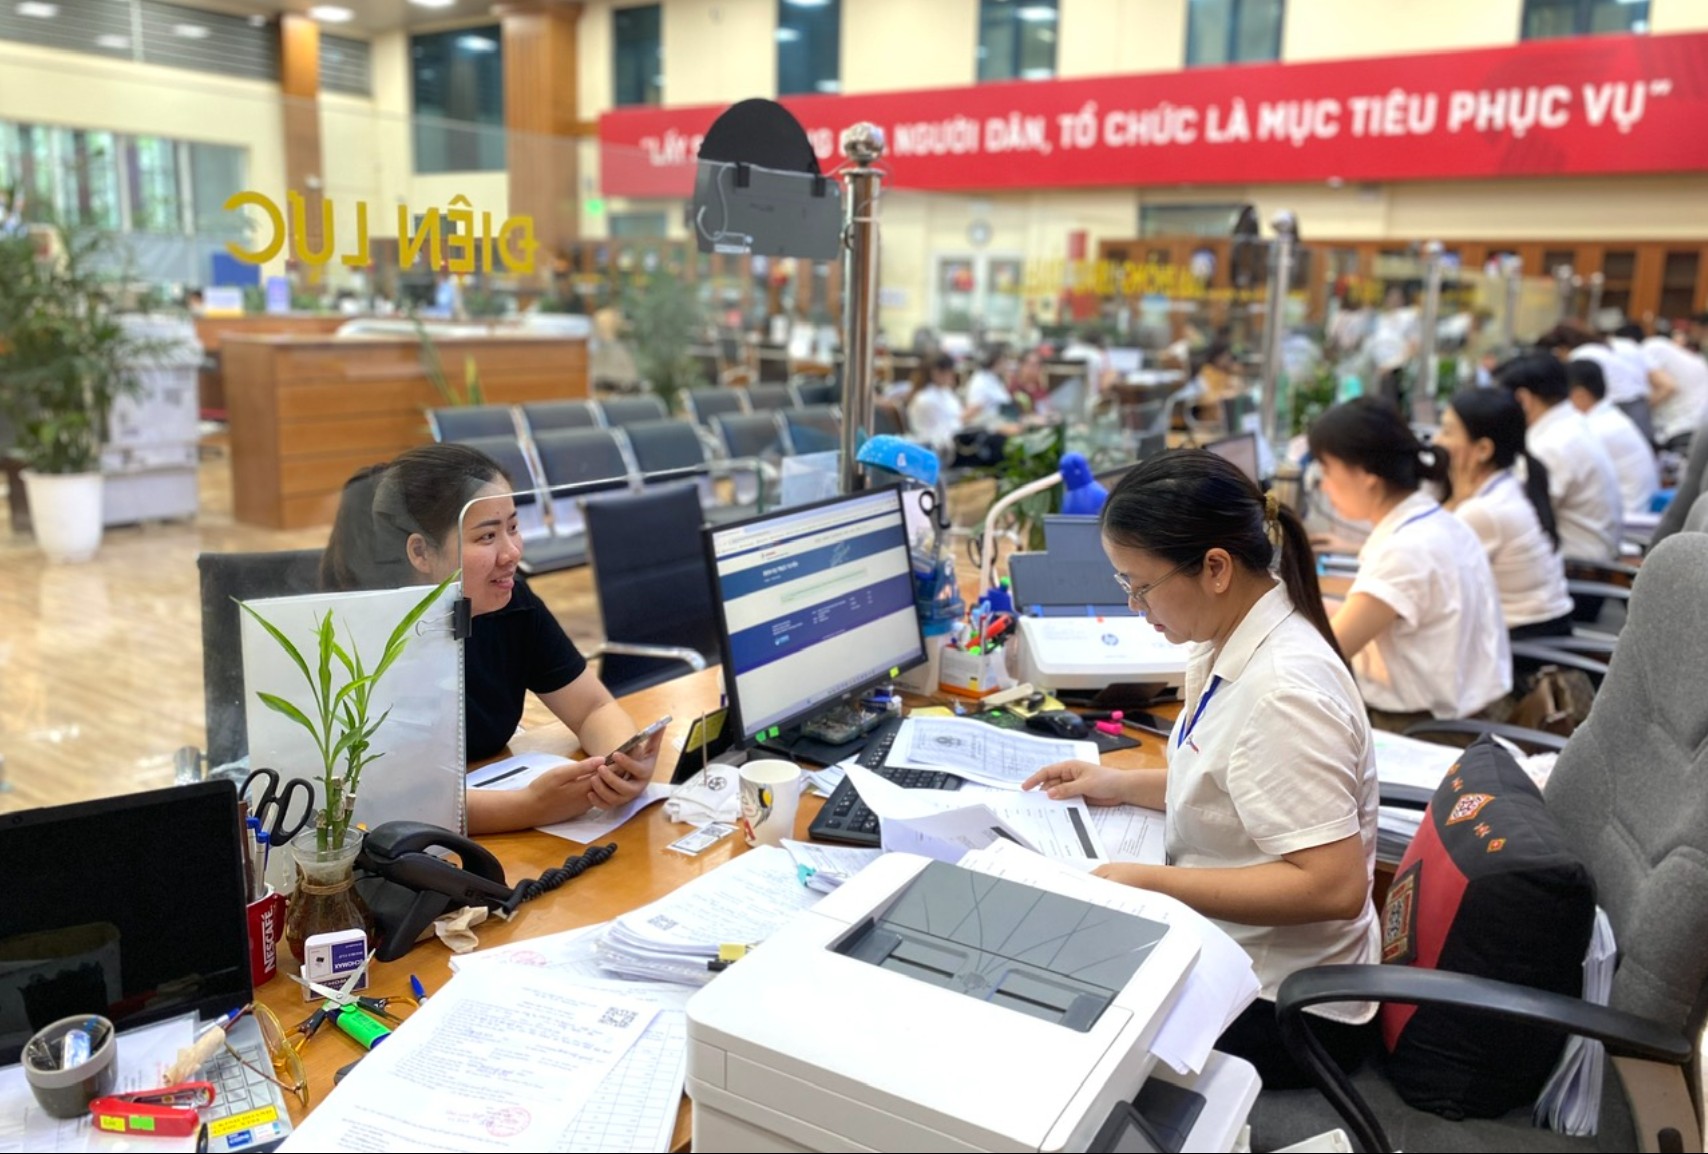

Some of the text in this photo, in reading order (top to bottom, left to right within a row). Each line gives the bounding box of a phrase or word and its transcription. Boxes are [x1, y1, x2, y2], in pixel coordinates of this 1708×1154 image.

[893, 115, 980, 156] NGƯỜI
[984, 111, 1053, 155] DÂN,
[1057, 100, 1098, 149] TỔ
[1103, 101, 1199, 147] CHỨC
[1205, 97, 1251, 143] LÀ
[1257, 98, 1341, 147] MỤC
[1347, 87, 1438, 137] TIÊU
[1447, 84, 1572, 138] PHỤC
